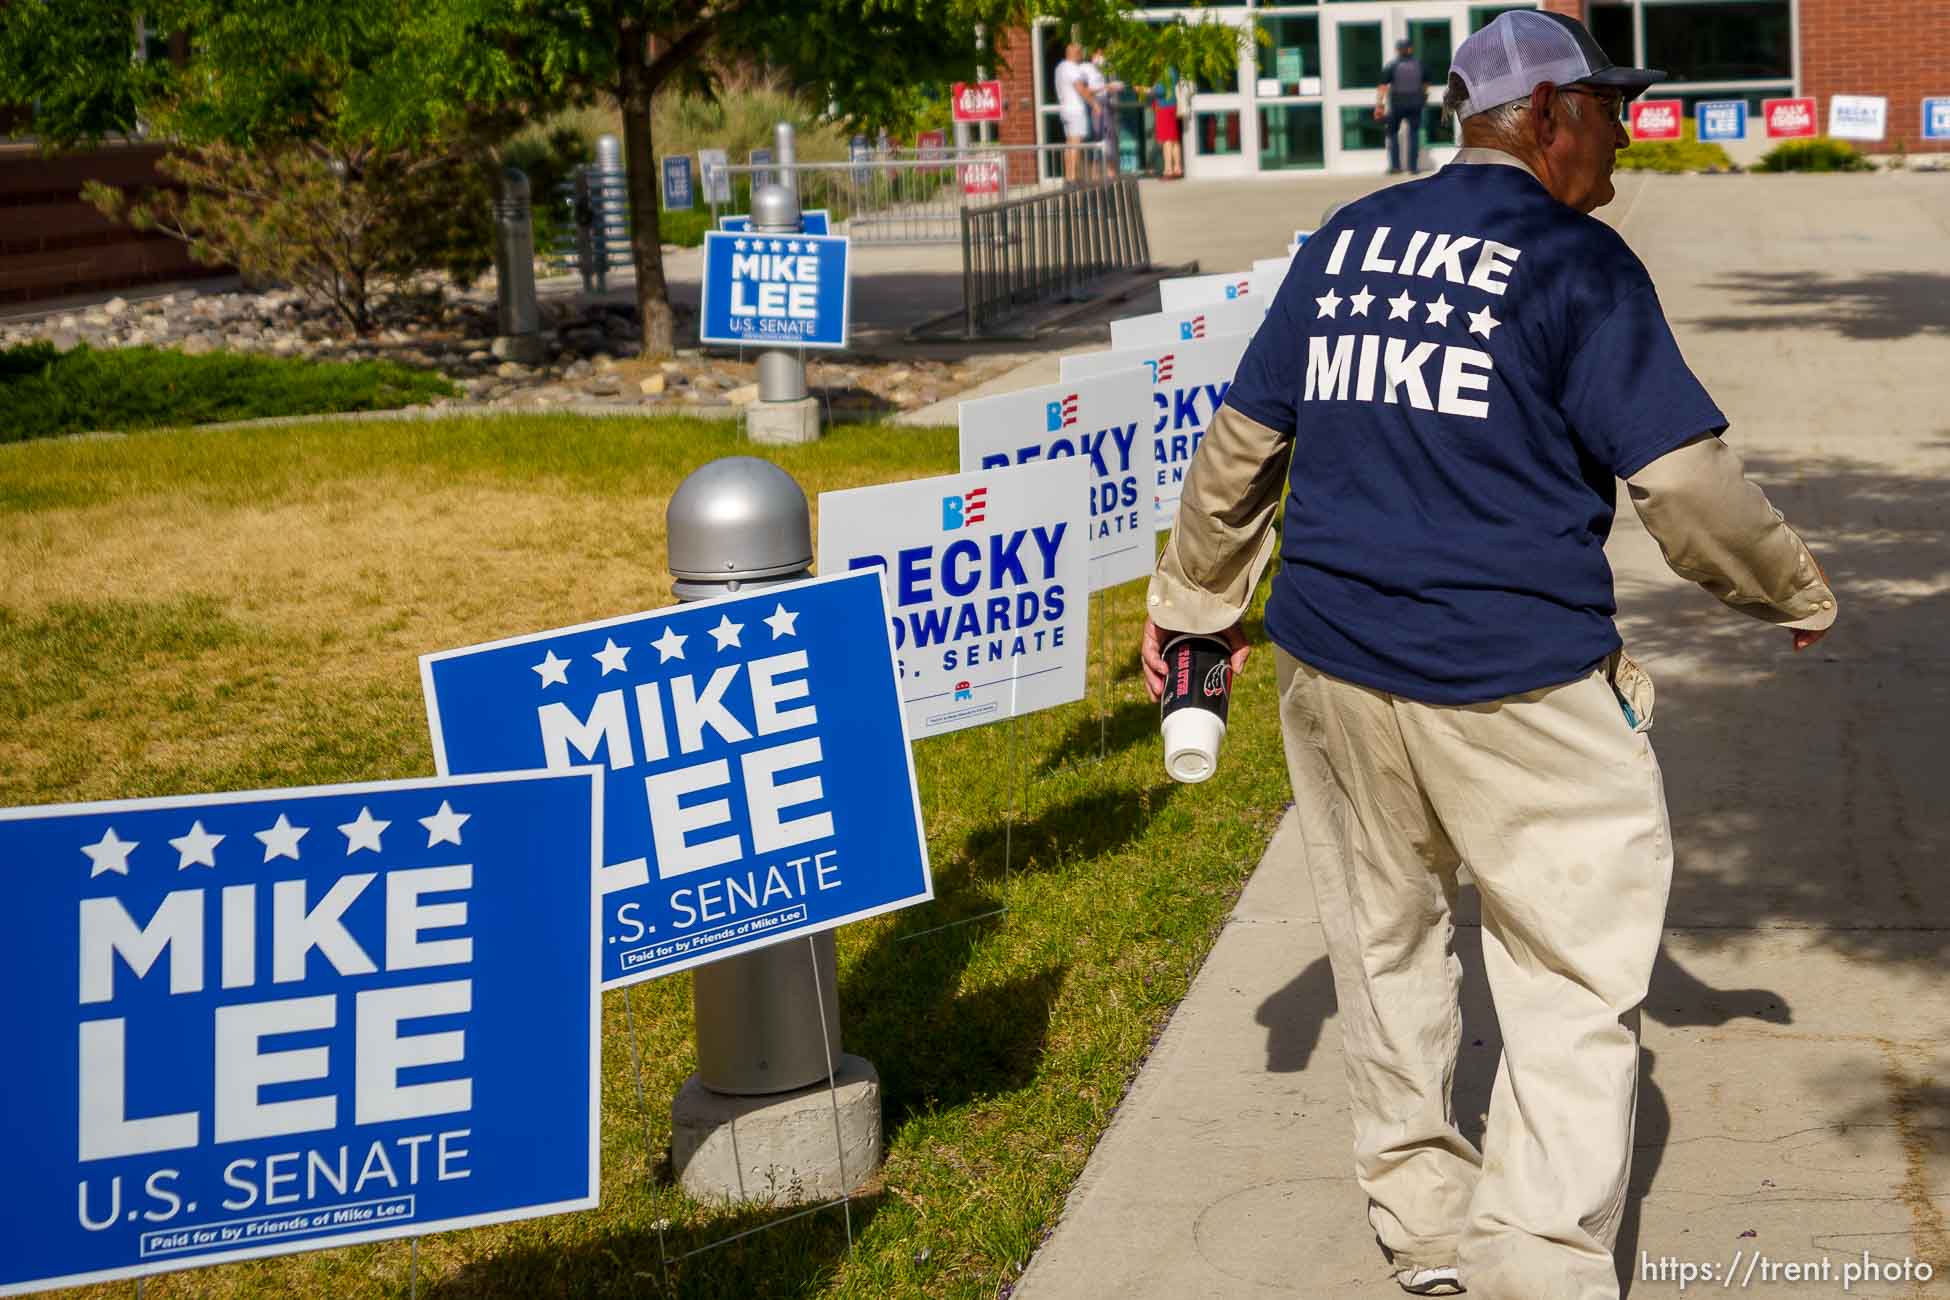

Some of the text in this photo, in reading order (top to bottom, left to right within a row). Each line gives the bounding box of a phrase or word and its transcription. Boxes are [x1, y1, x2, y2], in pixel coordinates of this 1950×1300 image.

[731, 252, 819, 282] MIKE
[1325, 226, 1521, 296] I LIKE
[729, 318, 755, 332] U.S.
[759, 319, 816, 336] SENATE
[730, 281, 818, 318] LEE
[1303, 334, 1494, 419] MIKE
[848, 521, 1068, 607] ECKY
[892, 584, 1065, 651] WARDS
[943, 626, 1065, 671] SENATE
[538, 650, 818, 770] MIKE
[608, 850, 842, 943] .S. SENATE
[79, 864, 474, 1005] MIKE
[628, 910, 801, 965] Paid for by Friends of Mike Lee
[78, 979, 473, 1163] LEE
[78, 1128, 472, 1232] U.S. SENATE
[150, 1203, 406, 1250] Paid for by Friends of Mike Lee
